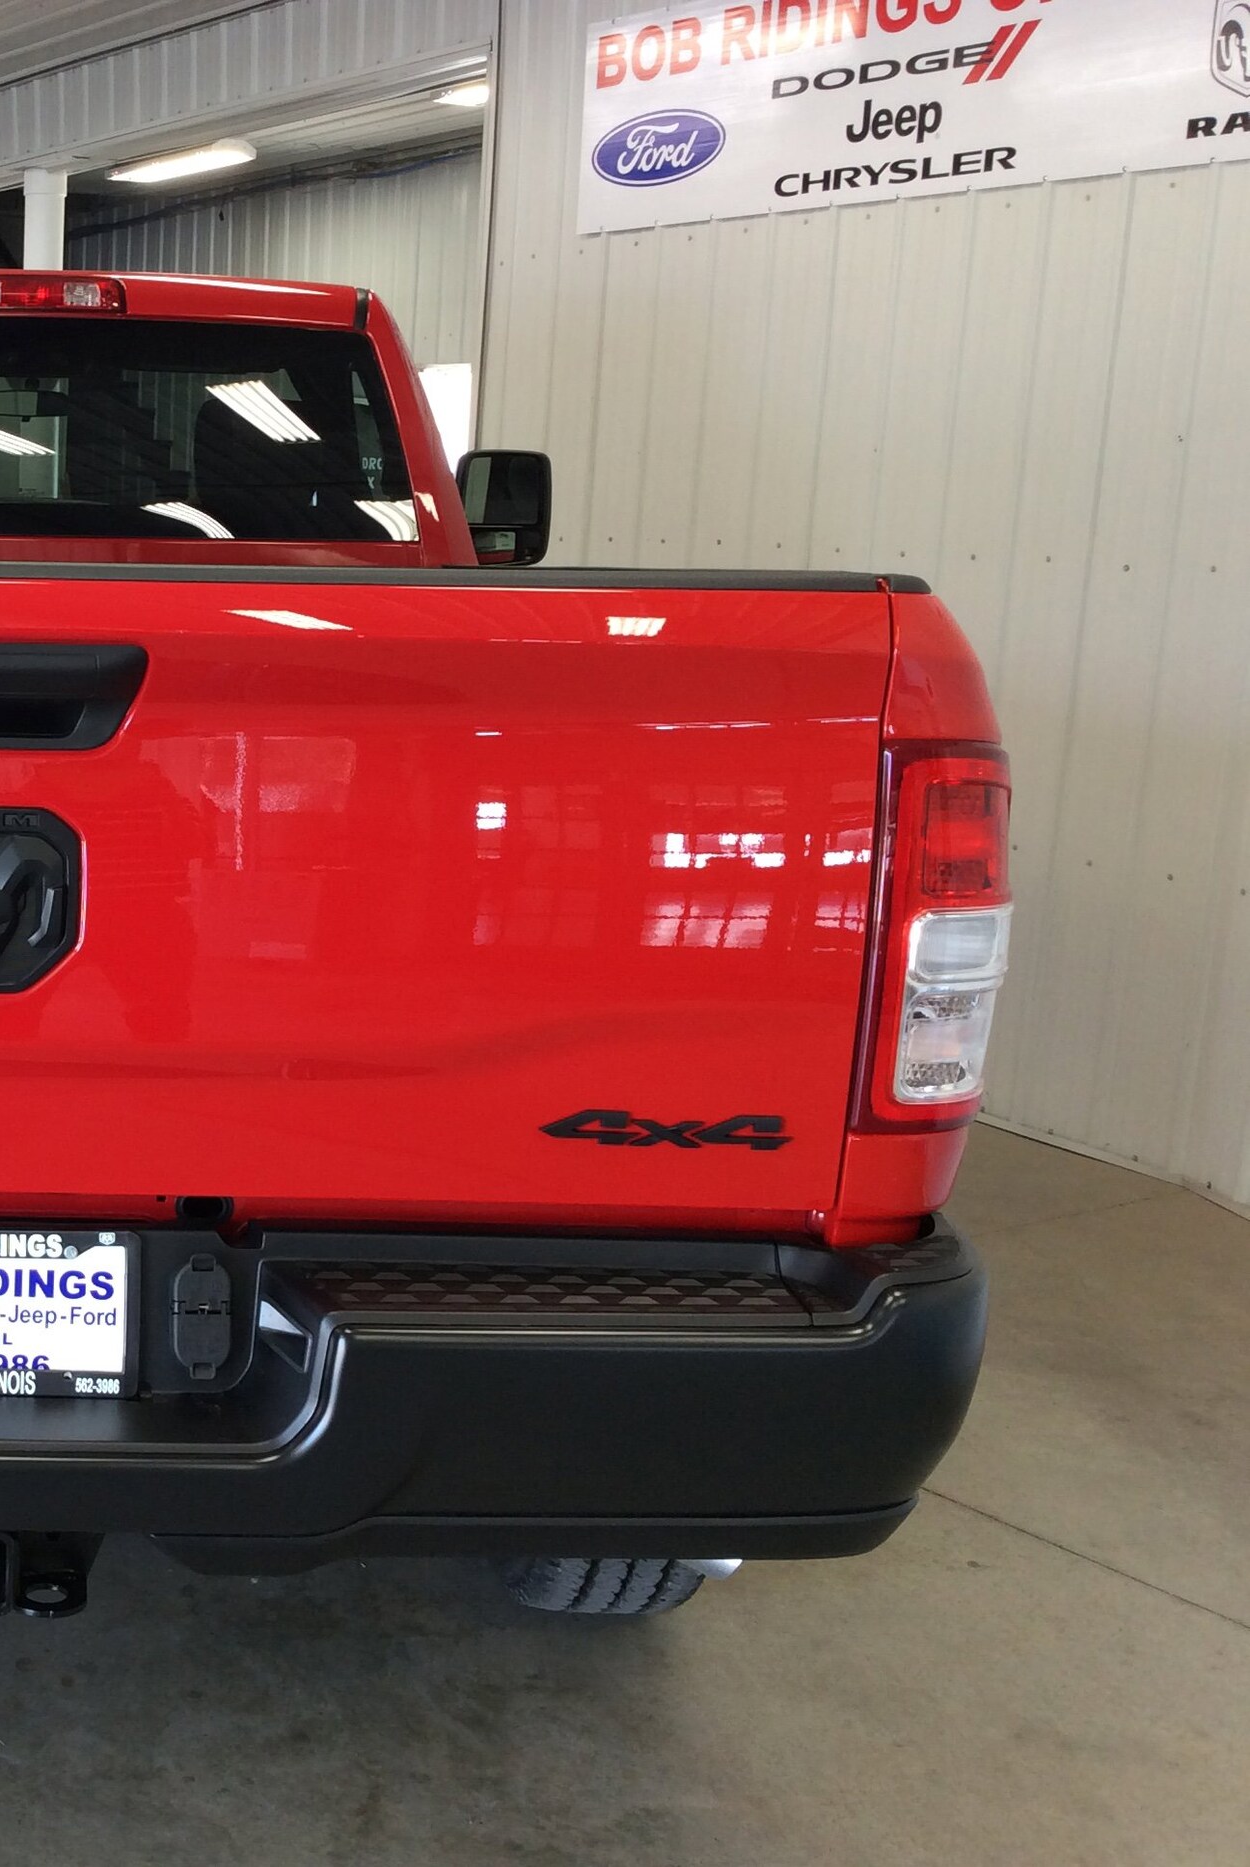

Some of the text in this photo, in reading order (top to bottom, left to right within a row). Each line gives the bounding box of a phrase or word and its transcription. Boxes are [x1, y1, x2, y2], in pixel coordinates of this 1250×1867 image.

[596, 17, 702, 89] BOB
[772, 41, 995, 99] DODGE
[847, 100, 942, 143] Jeep
[616, 123, 695, 174] Ford
[774, 146, 1016, 197] CHRYSLER
[75, 1377, 120, 1394] 562-3986
